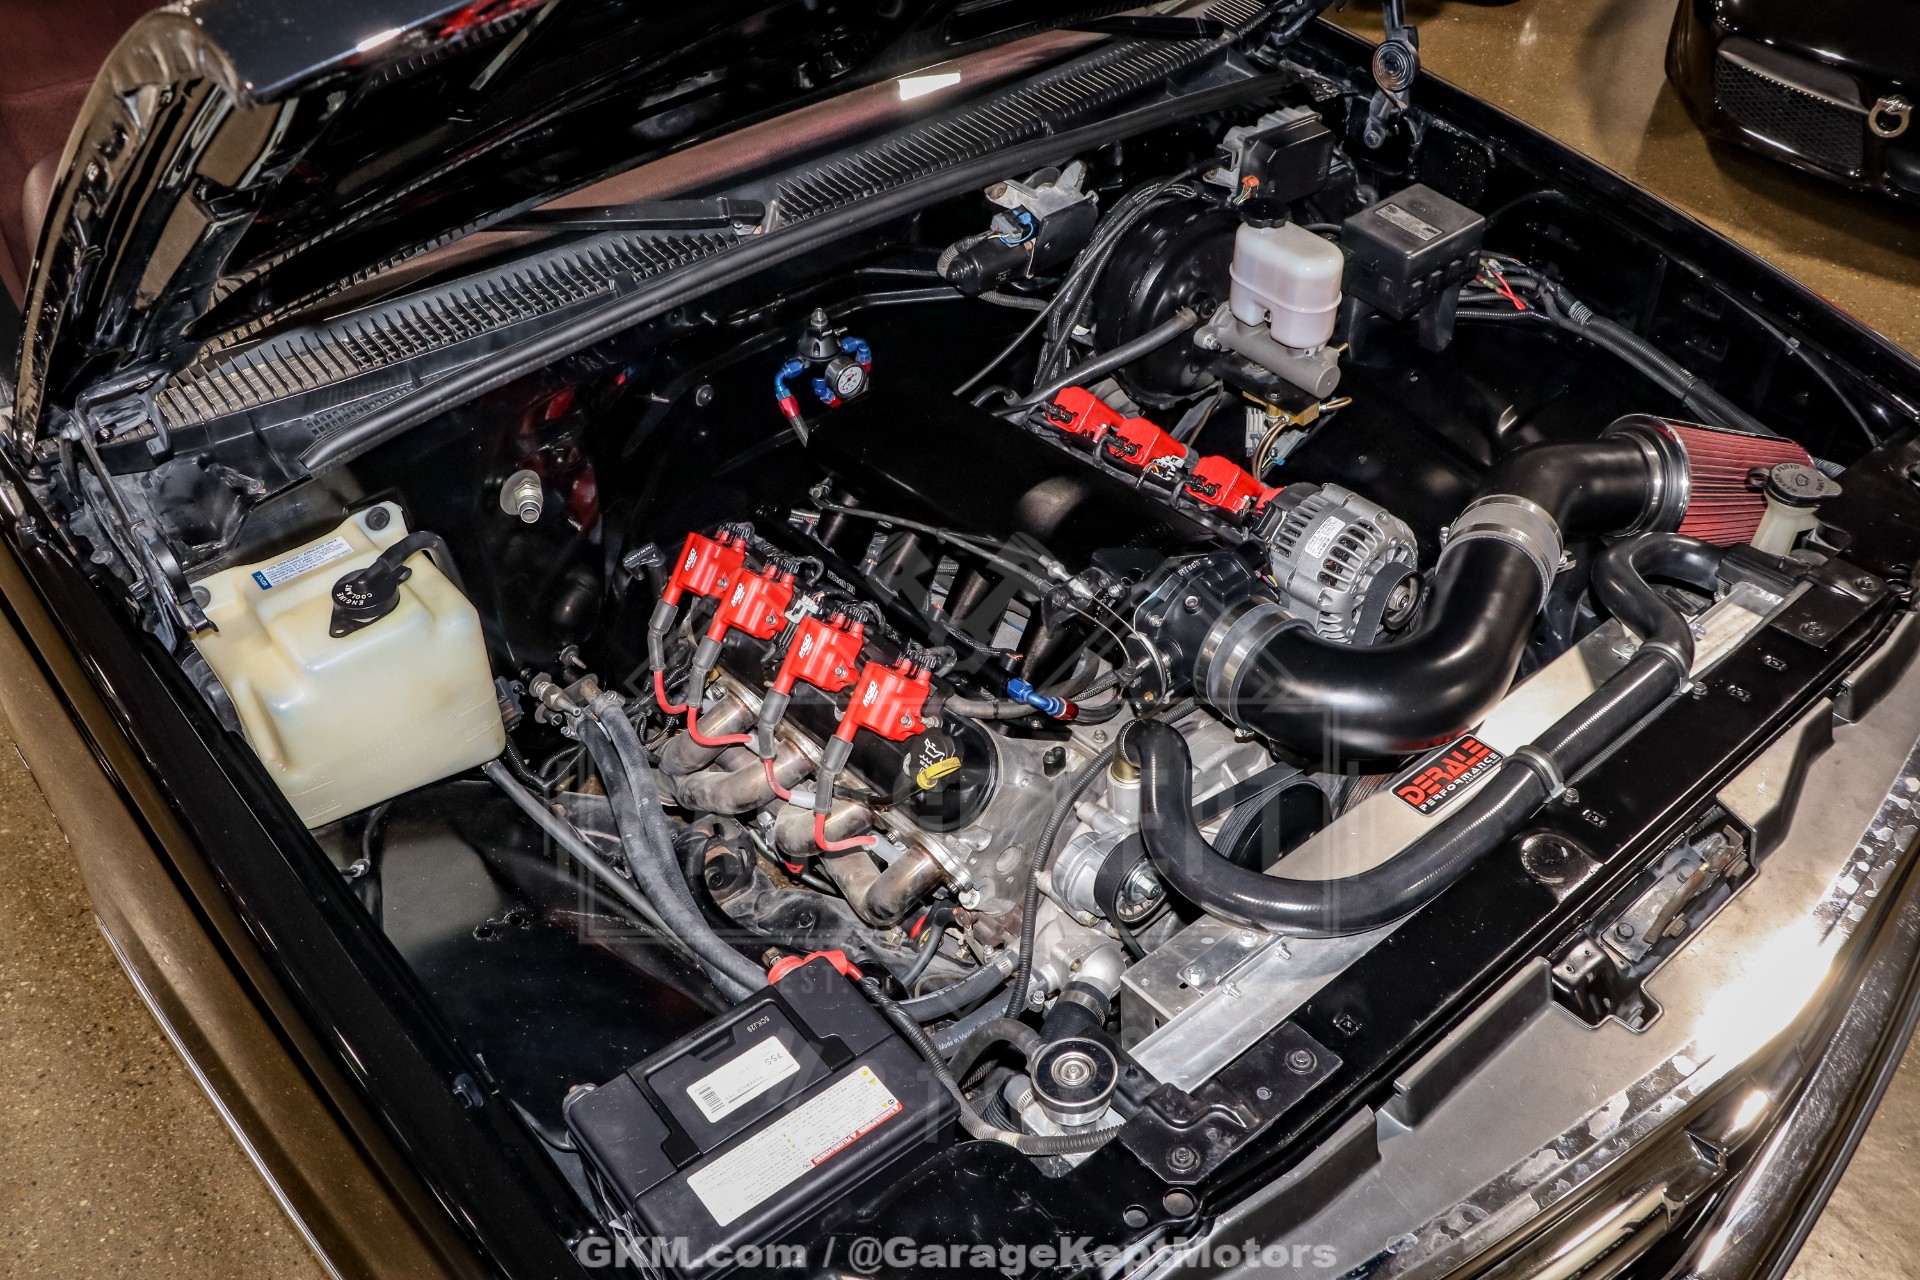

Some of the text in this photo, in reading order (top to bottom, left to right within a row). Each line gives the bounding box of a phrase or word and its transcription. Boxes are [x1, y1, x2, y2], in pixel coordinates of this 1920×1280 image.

[684, 547, 697, 572] MSD
[336, 591, 364, 606] ENGINE
[344, 583, 373, 600] COOLANT
[730, 582, 744, 608] MSD
[798, 633, 812, 659] MSD
[862, 680, 876, 708] MSD
[1397, 739, 1492, 808] DERALE
[1418, 752, 1500, 812] PERFORMANCE
